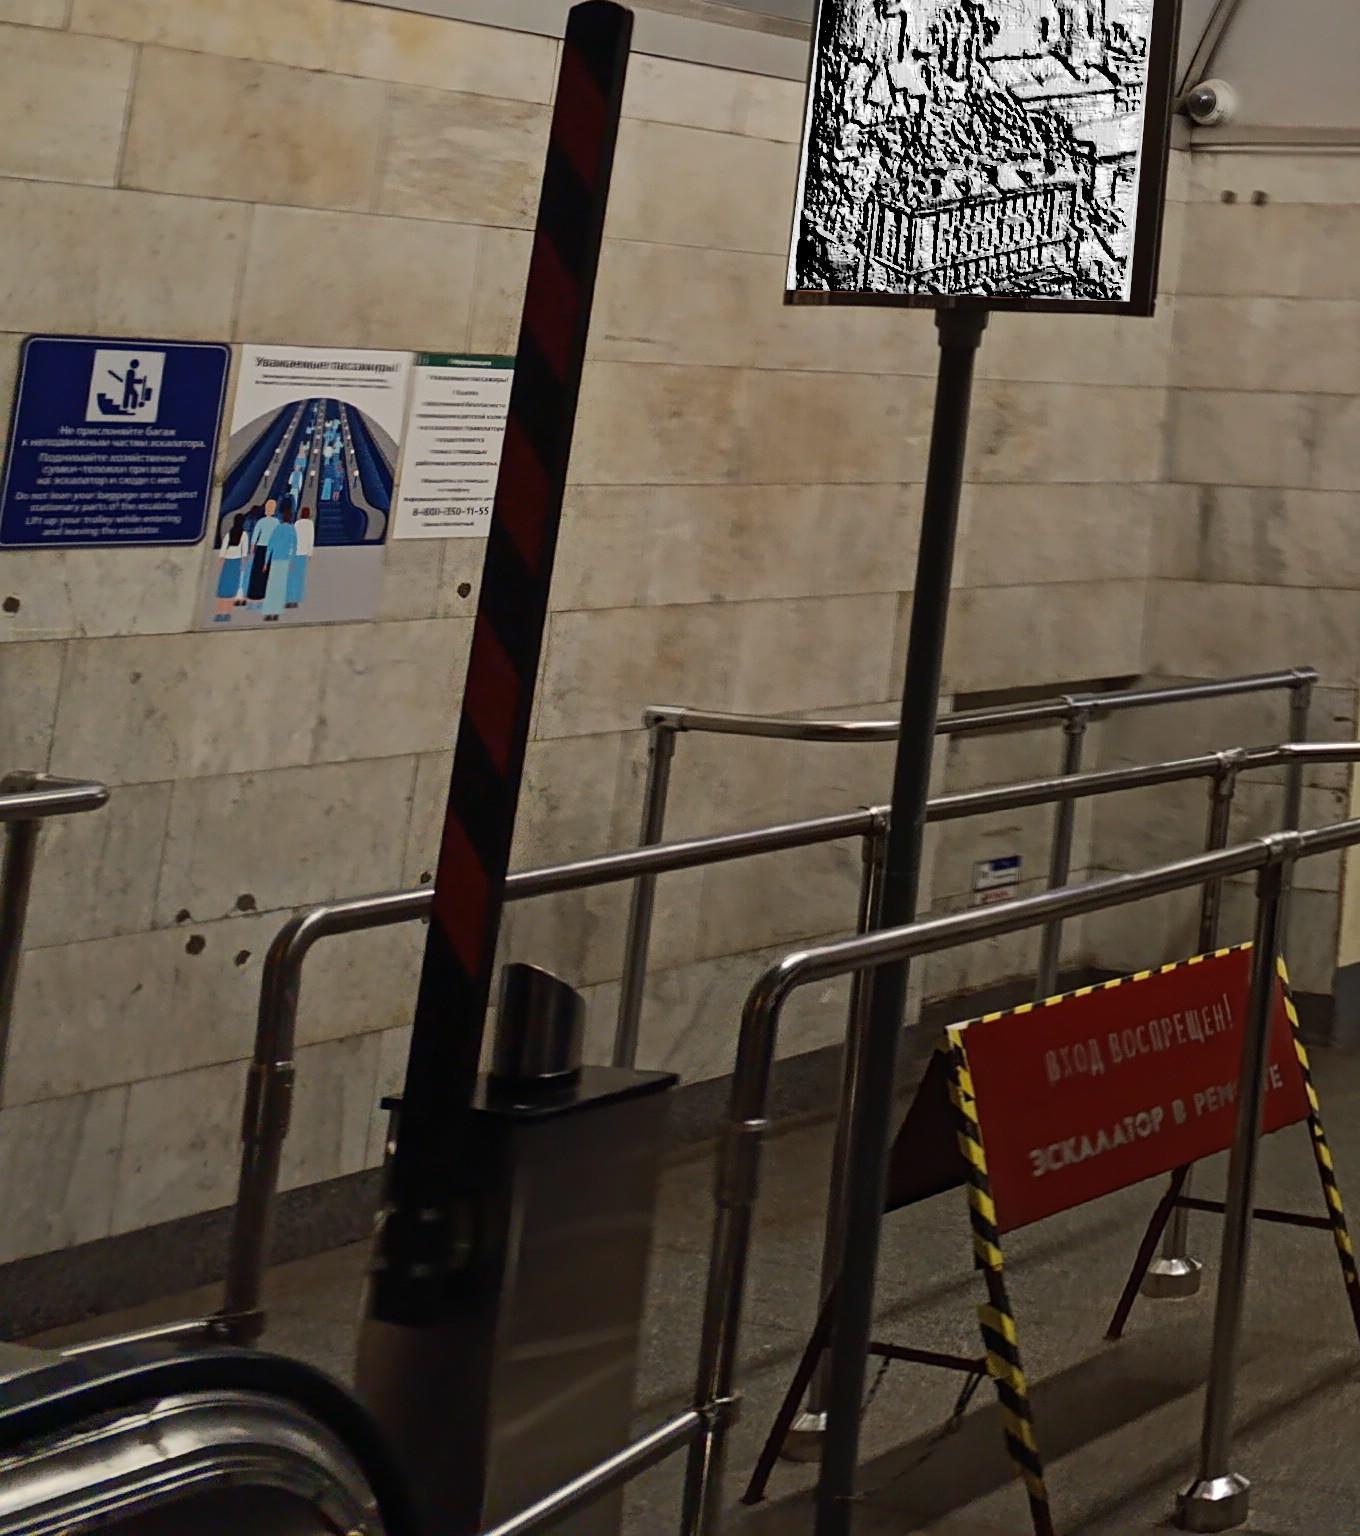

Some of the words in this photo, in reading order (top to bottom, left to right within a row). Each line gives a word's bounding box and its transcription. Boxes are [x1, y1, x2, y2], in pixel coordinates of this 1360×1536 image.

[1046, 1037, 1105, 1083] ВХОД
[1108, 992, 1234, 1064] ВОСПРЕЩЕН!
[1028, 1105, 1164, 1177] ЭСКАЛАТОР
[1171, 1098, 1188, 1125] В
[1193, 1064, 1283, 1117] РЕМЕ
